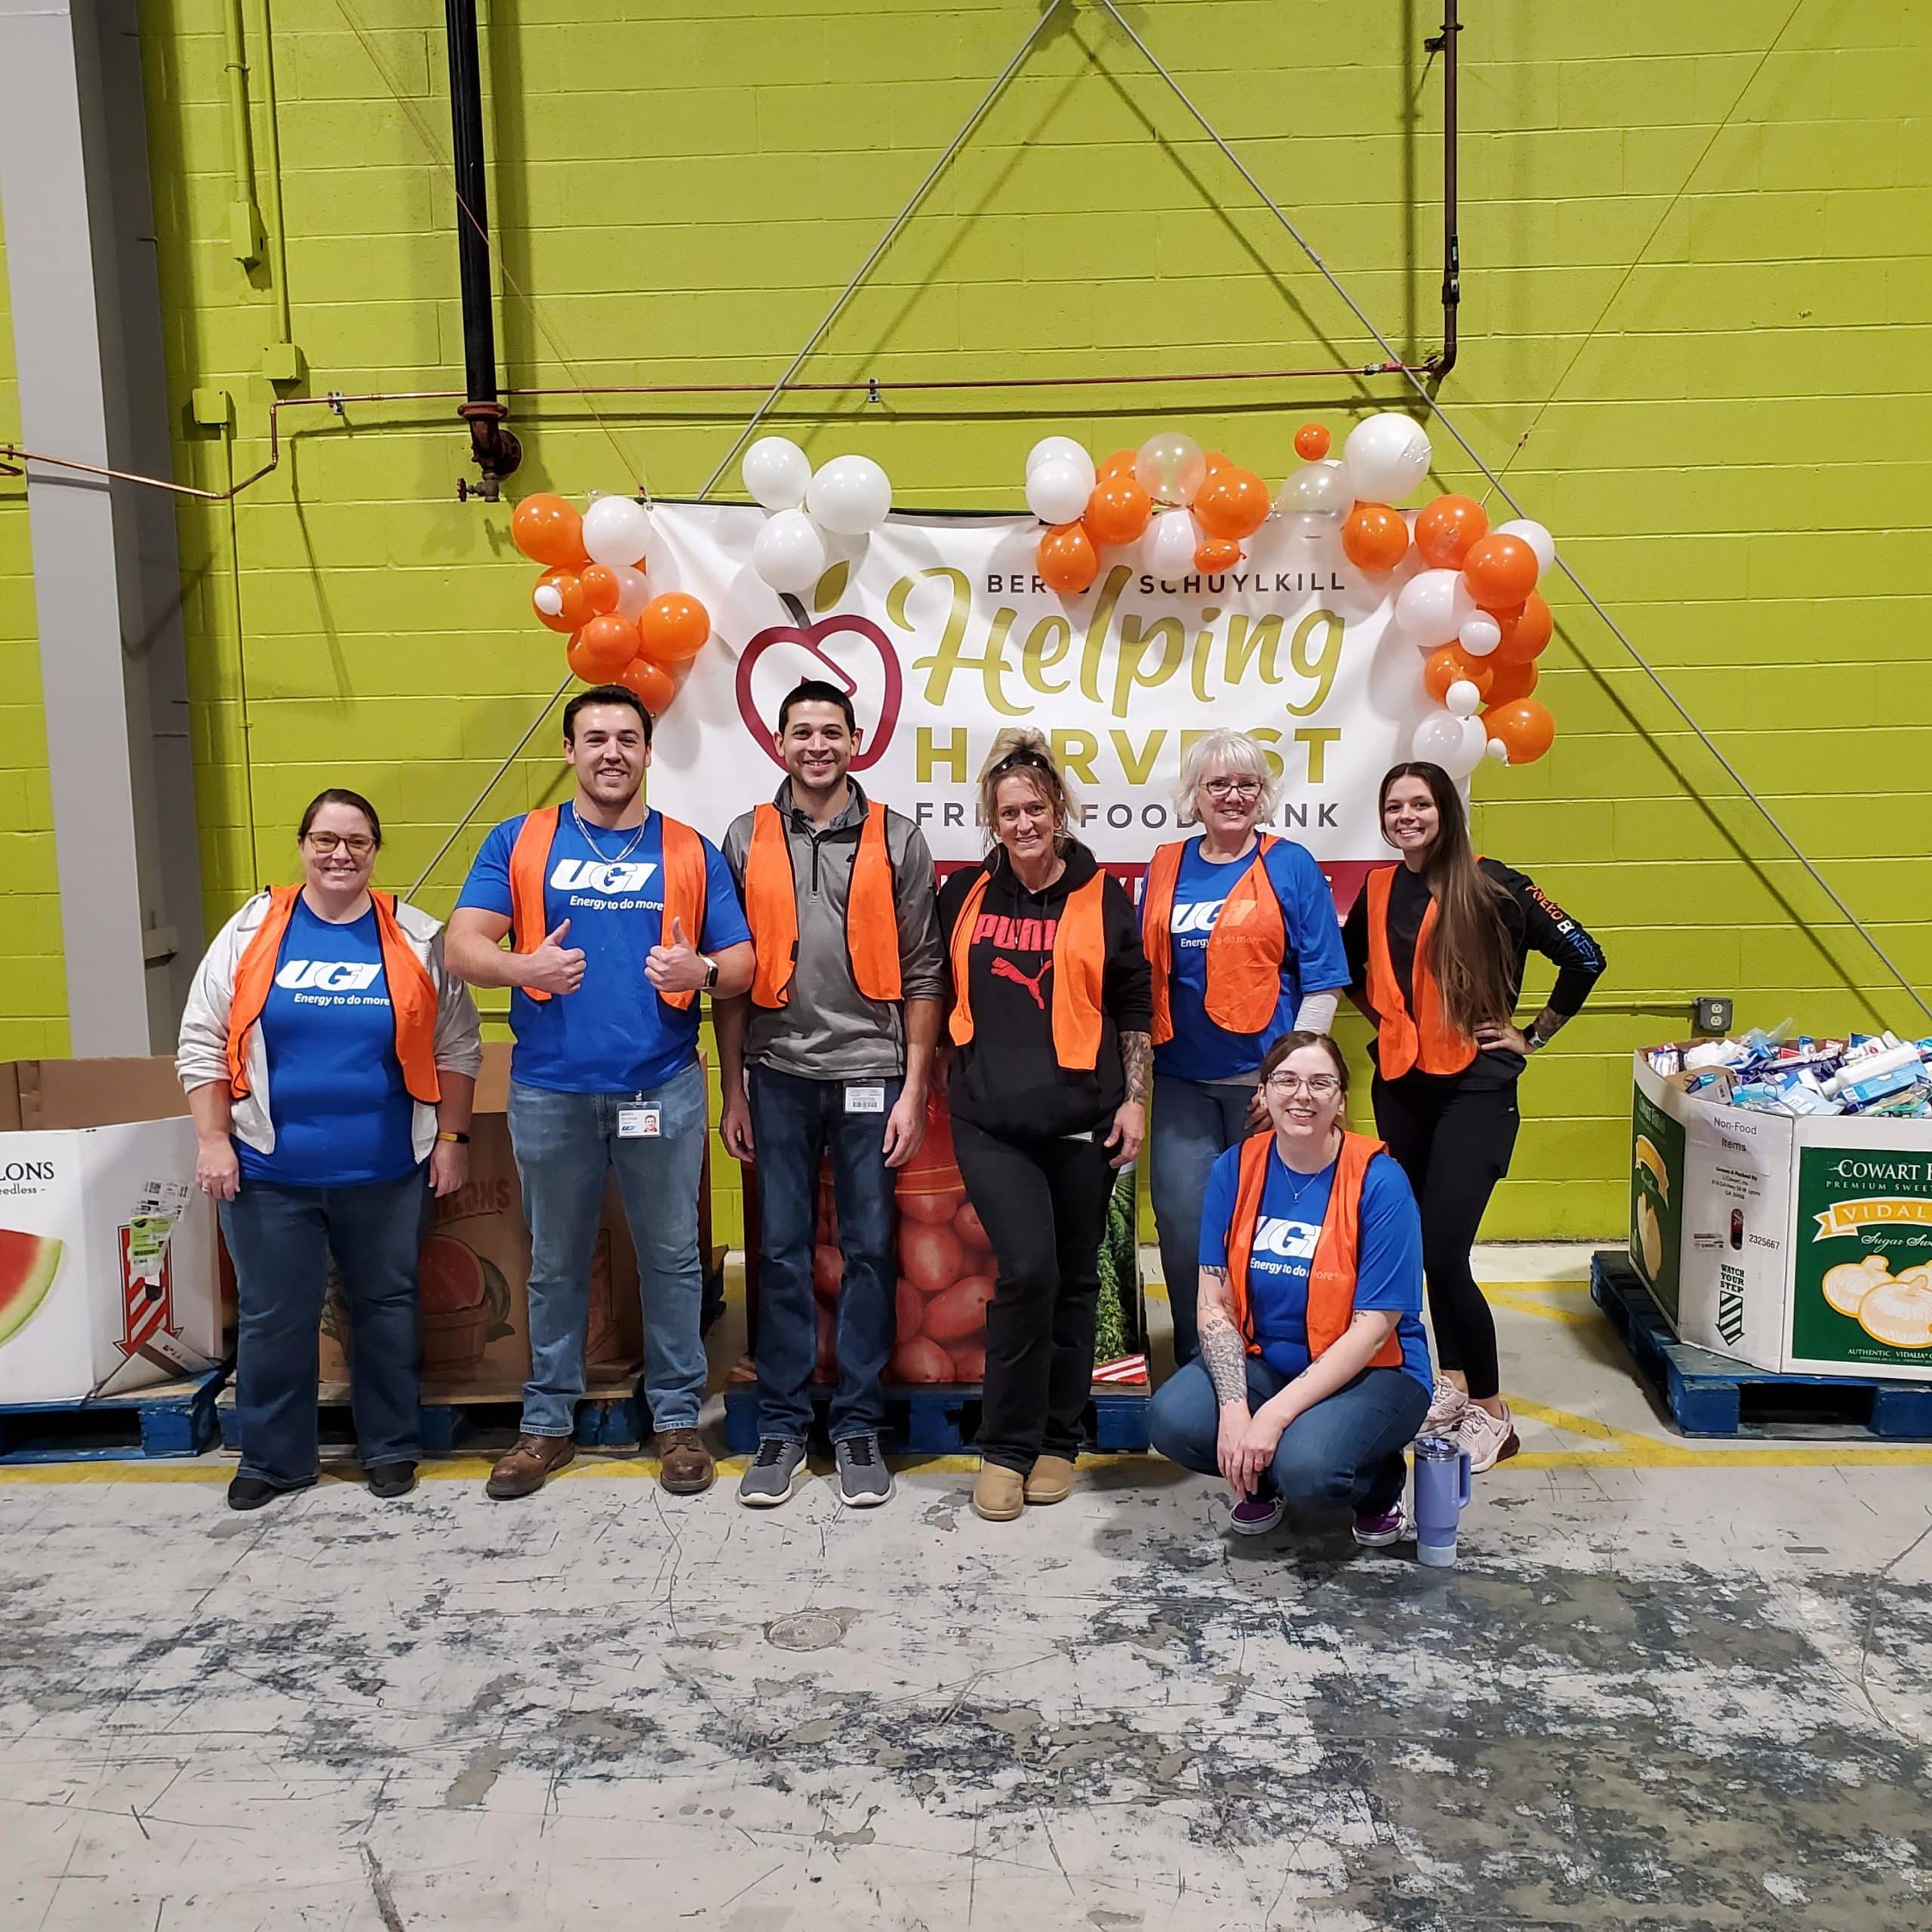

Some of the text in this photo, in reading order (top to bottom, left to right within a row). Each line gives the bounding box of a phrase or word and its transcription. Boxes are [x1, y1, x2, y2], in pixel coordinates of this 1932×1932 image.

[987, 572, 1345, 595] BER SCHUYLKILL
[887, 565, 1345, 718] Helping
[915, 727, 1342, 785] HRVST
[915, 802, 986, 827] FR
[549, 859, 658, 894] UGI
[570, 896, 663, 911] Energy to do more
[971, 914, 1057, 951] PUM
[1180, 938, 1210, 949] Energy
[274, 959, 383, 991] UGI
[294, 993, 390, 1006] Energy to do more
[1714, 1117, 1757, 1135] Non-Food
[1721, 1137, 1747, 1152] Items
[0, 1161, 54, 1181] ONS
[1838, 1159, 1921, 1180] COWART
[1826, 1180, 1887, 1190] PREMIUM
[1842, 1204, 1930, 1221] VIDAL
[1253, 1216, 1327, 1259] UGI
[1749, 1233, 1780, 1250] 2325667
[1860, 1232, 1904, 1254] Sugar
[1250, 1258, 1334, 1281] Energy to do ore
[1720, 1272, 1745, 1286] YOUR
[1721, 1263, 1745, 1278] WATCH
[1720, 1280, 1744, 1294] STEP
[1847, 1348, 1891, 1357] AUTHENTIC
